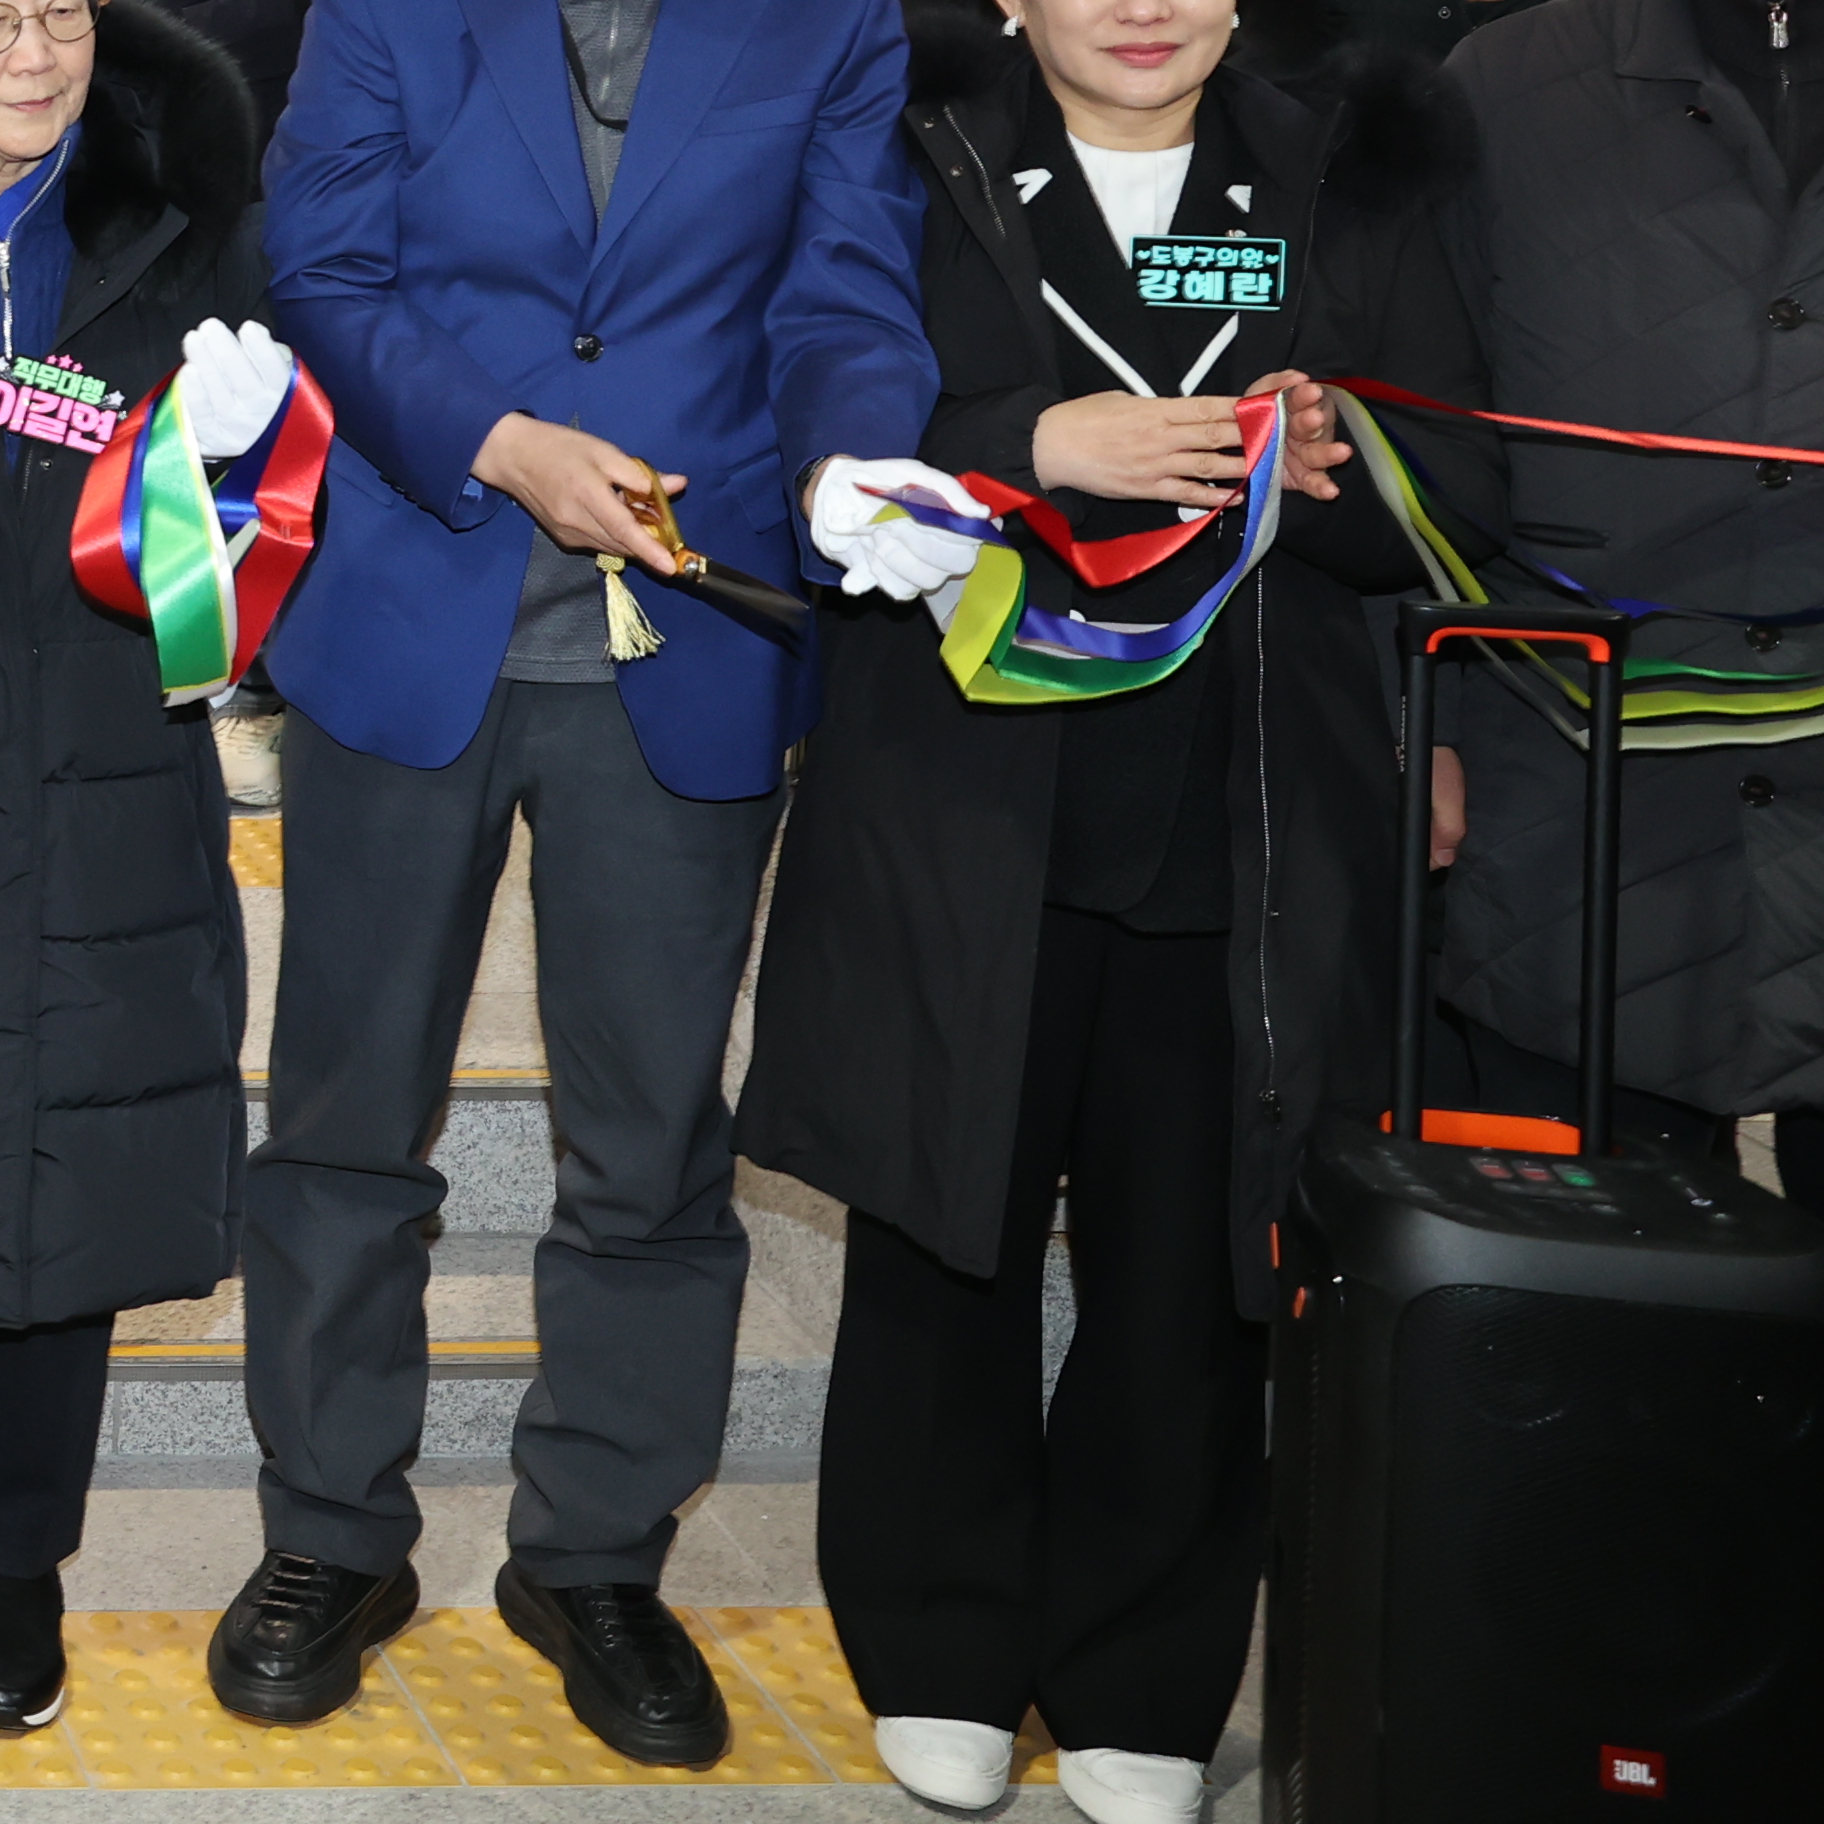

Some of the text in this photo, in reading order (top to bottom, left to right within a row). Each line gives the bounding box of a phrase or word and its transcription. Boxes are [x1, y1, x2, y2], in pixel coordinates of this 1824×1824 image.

[1149, 245, 1264, 269] 도봉구의원
[1136, 268, 1273, 304] 강혜란
[12, 356, 107, 406] 직무대행
[1613, 1759, 1657, 1786] JBL
